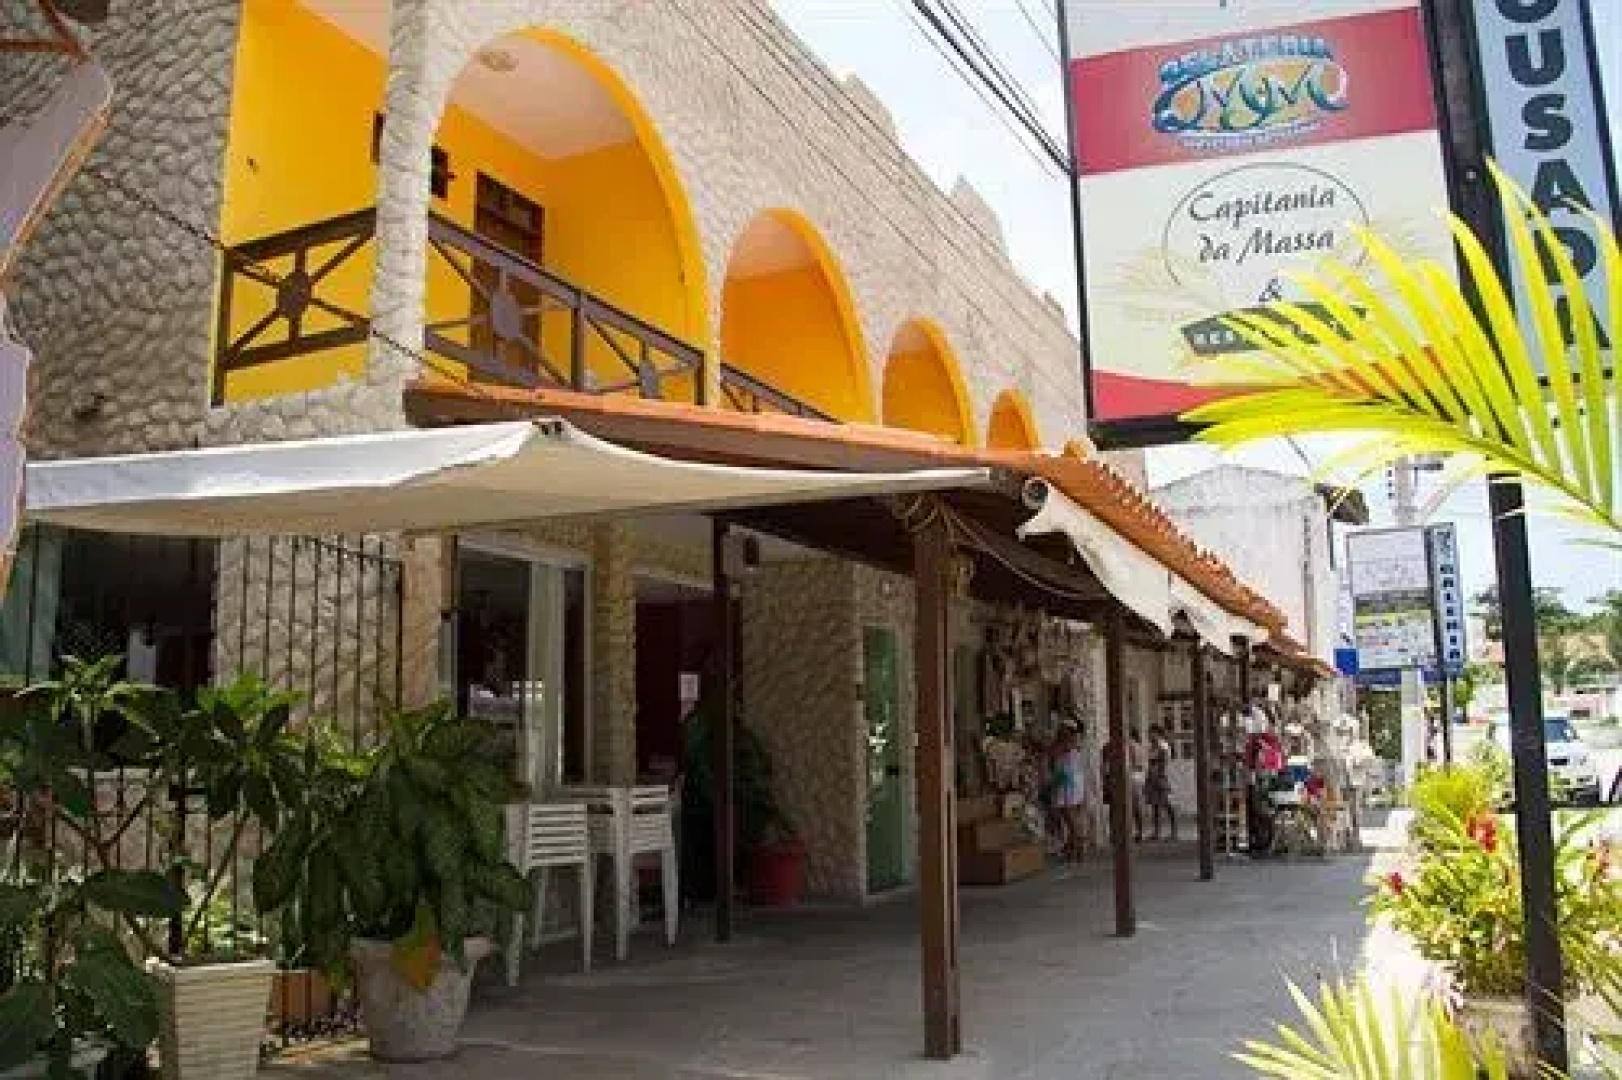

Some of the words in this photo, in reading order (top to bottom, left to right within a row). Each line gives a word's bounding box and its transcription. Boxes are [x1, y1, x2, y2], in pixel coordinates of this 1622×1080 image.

[1188, 185, 1334, 229] Capitania
[1199, 234, 1230, 263] da
[1236, 227, 1334, 266] Massa
